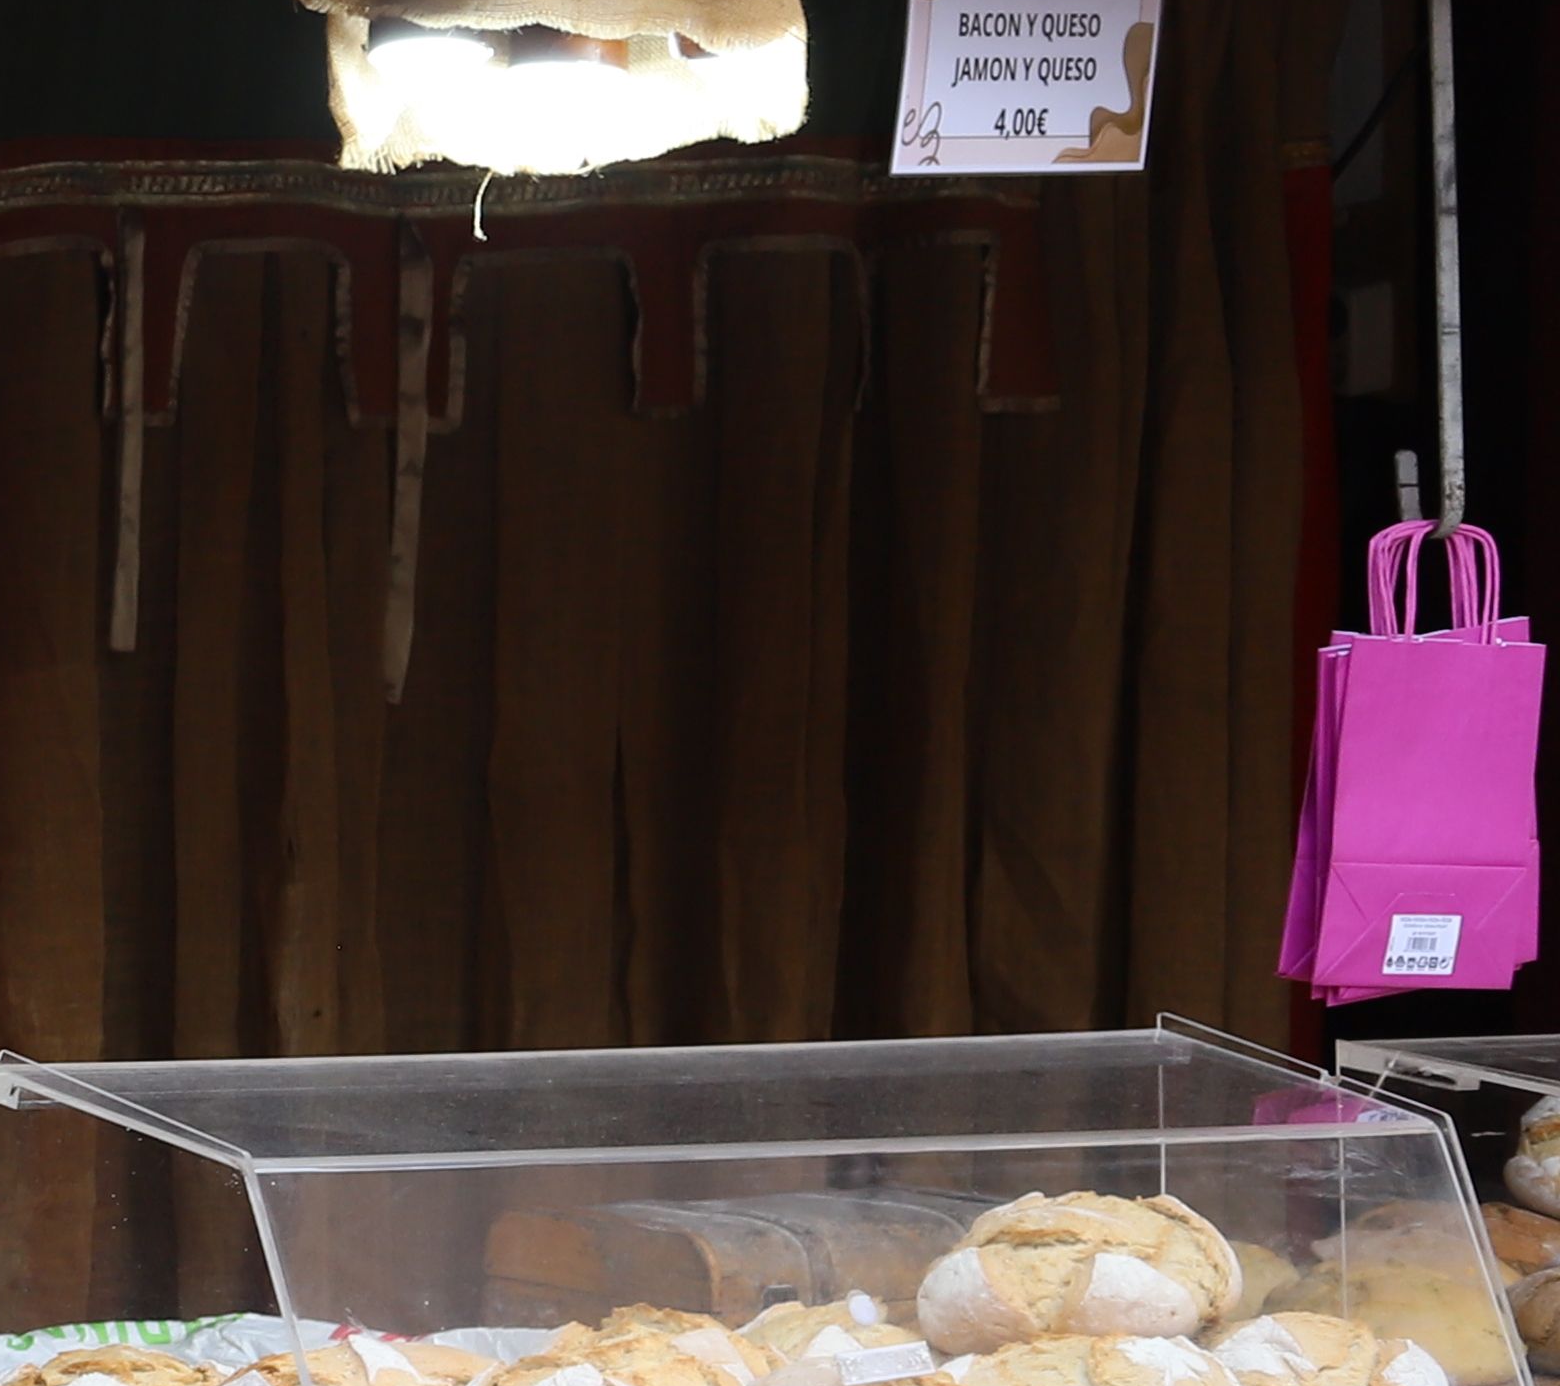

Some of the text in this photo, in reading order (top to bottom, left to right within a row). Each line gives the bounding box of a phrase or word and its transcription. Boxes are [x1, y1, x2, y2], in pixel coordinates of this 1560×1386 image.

[958, 12, 1102, 42] BACON Y QUESO
[951, 56, 1097, 88] JAMON Y QUESO
[994, 107, 1049, 140] 4,00€
